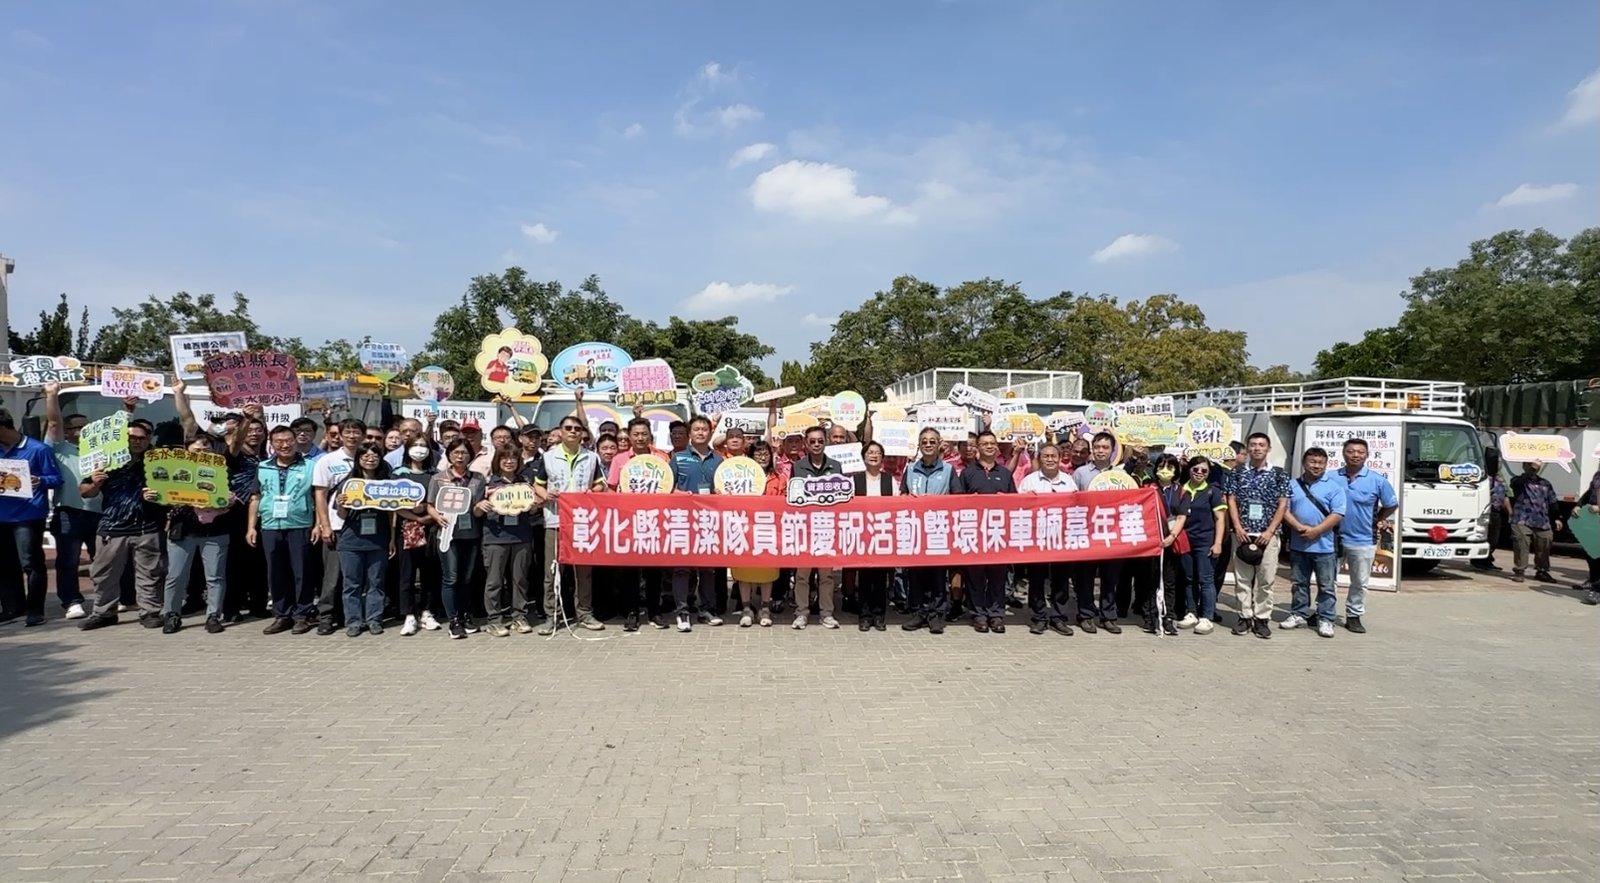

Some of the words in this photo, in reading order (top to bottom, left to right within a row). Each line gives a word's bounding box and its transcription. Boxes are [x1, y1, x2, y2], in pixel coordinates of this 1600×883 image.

[208, 353, 288, 374] 感謝縣長
[413, 409, 487, 420] 救災能全面升級
[368, 485, 420, 497] 低碳垃圾車
[807, 481, 850, 491] 資源回收車
[1423, 508, 1453, 516] ISUZU
[572, 503, 1148, 557] 彰化縣清潔隊員節慶祝活動暨環保車輛嘉年華
